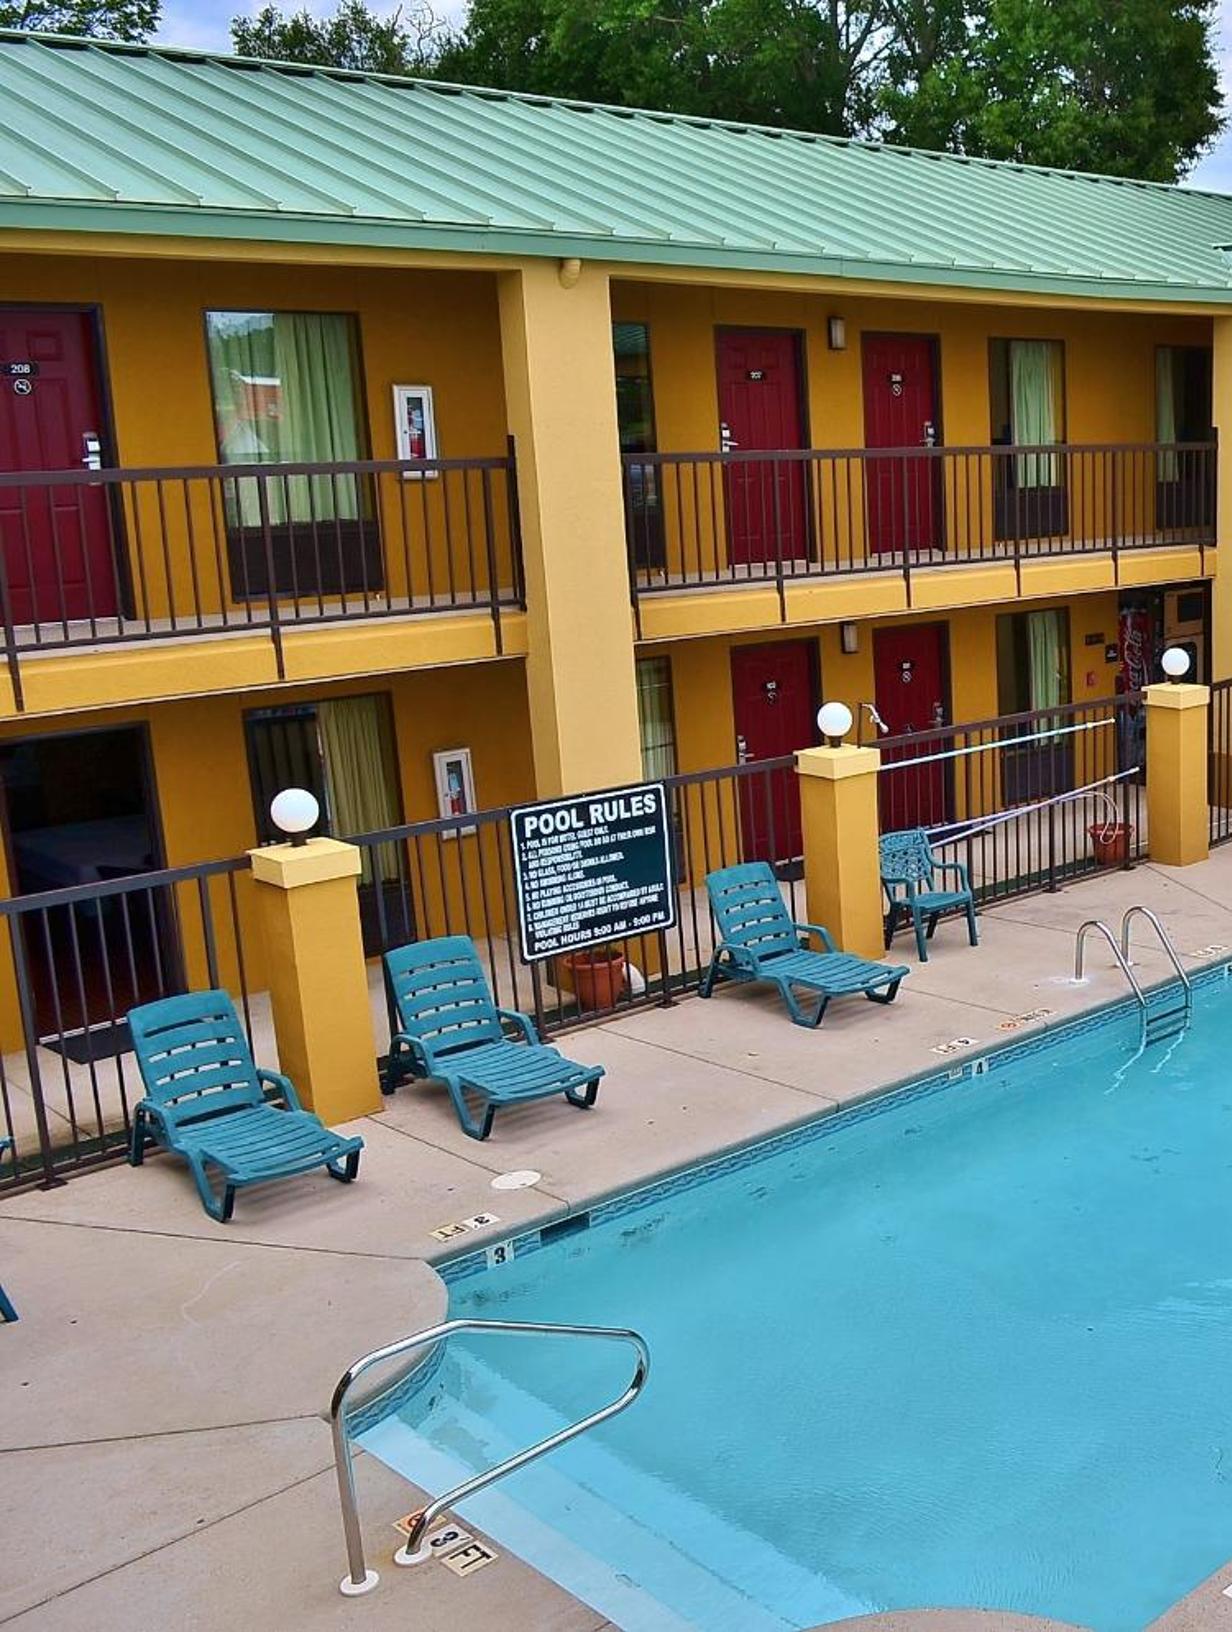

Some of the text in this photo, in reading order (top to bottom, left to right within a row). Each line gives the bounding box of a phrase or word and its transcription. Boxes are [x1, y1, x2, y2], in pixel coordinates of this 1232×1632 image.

[11, 364, 31, 374] 208
[523, 793, 656, 838] POOL RULES
[534, 936, 558, 951] POOL
[560, 928, 591, 944] HOURS
[593, 924, 611, 936] 9:00
[613, 920, 626, 932] AM
[632, 914, 650, 927] 9:00
[651, 911, 665, 922] PM
[449, 1544, 492, 1570] FT
